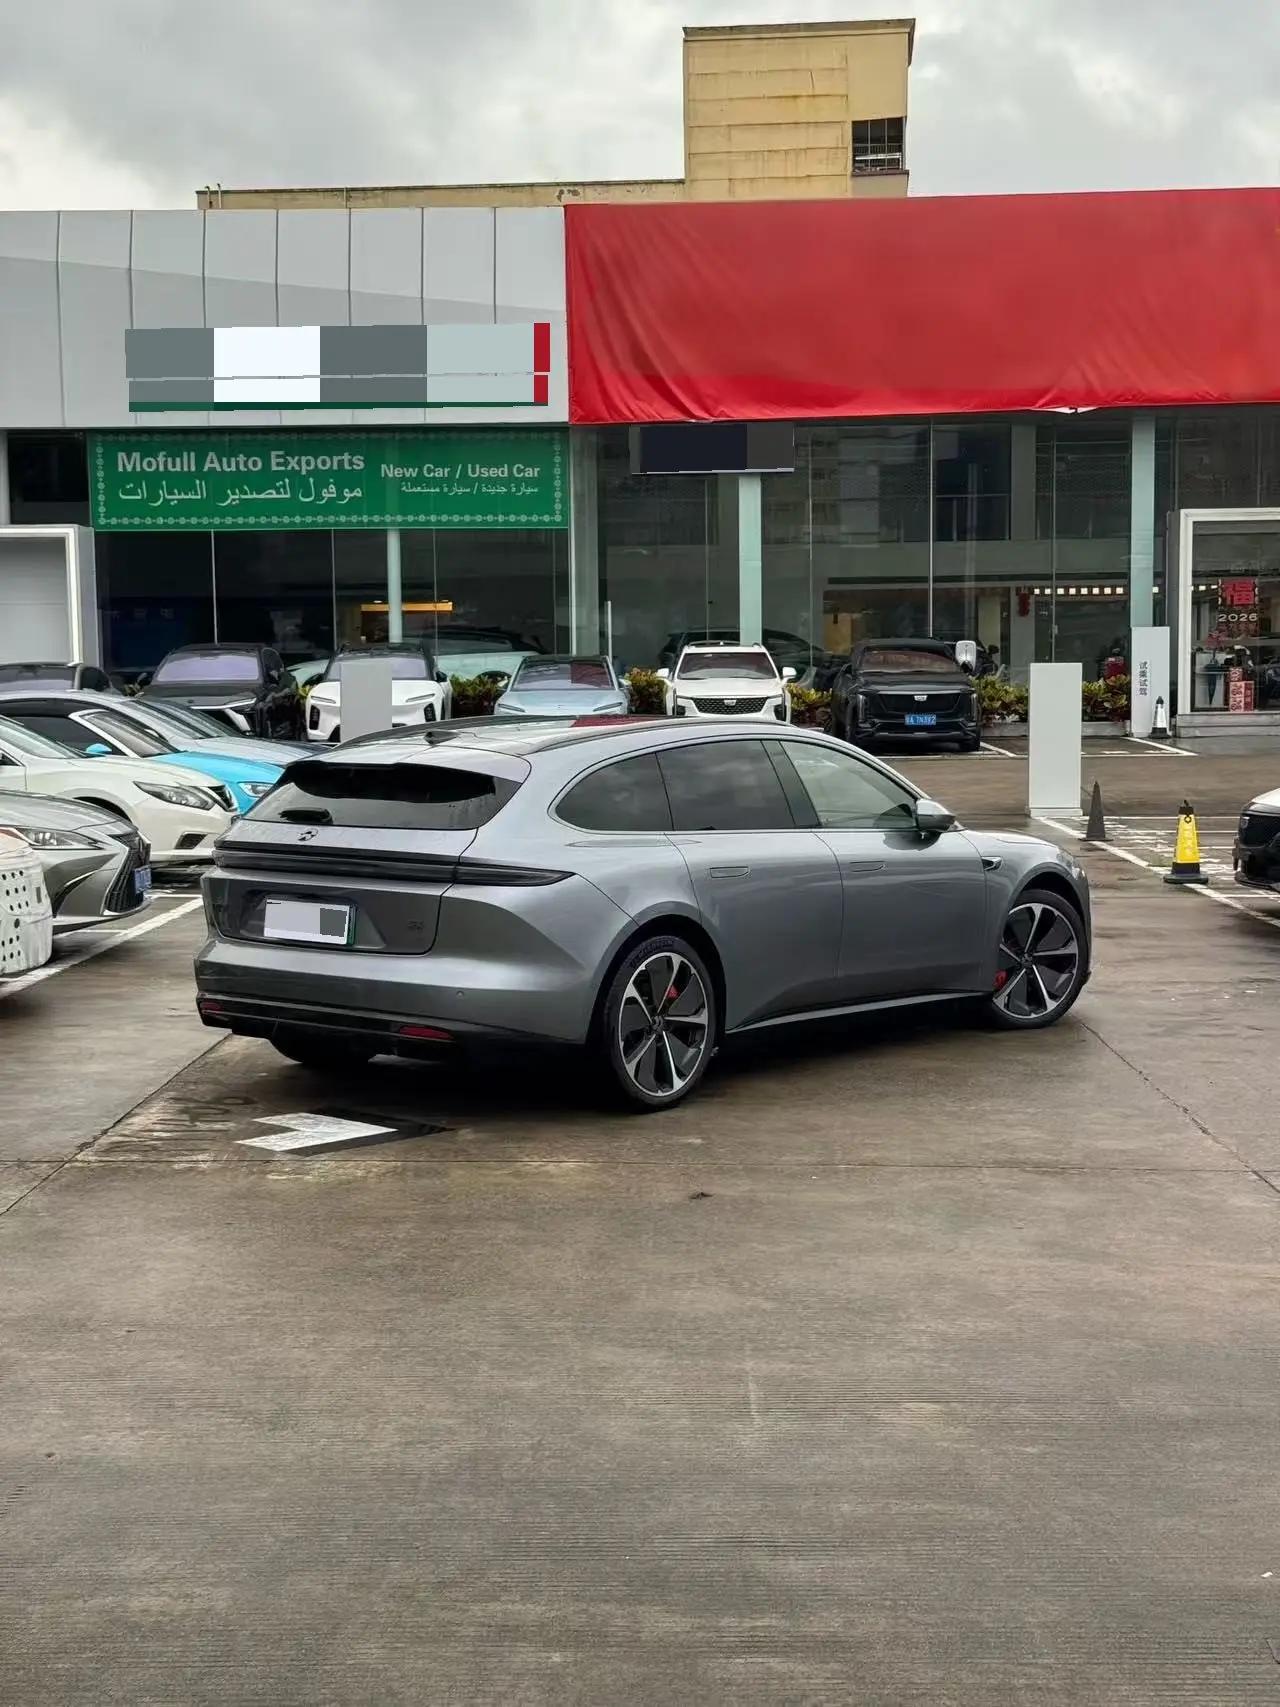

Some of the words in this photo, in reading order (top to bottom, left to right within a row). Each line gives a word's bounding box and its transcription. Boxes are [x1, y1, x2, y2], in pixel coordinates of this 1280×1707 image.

[117, 451, 196, 472] Mofull
[203, 451, 263, 472] Auto
[270, 450, 366, 475] Exports
[381, 463, 418, 478] New
[423, 463, 451, 478] Car
[468, 463, 508, 478] Used
[513, 463, 540, 478] Car
[119, 479, 207, 507] السيارات
[216, 477, 291, 507] لتصدير
[1218, 613, 1258, 622] 2026
